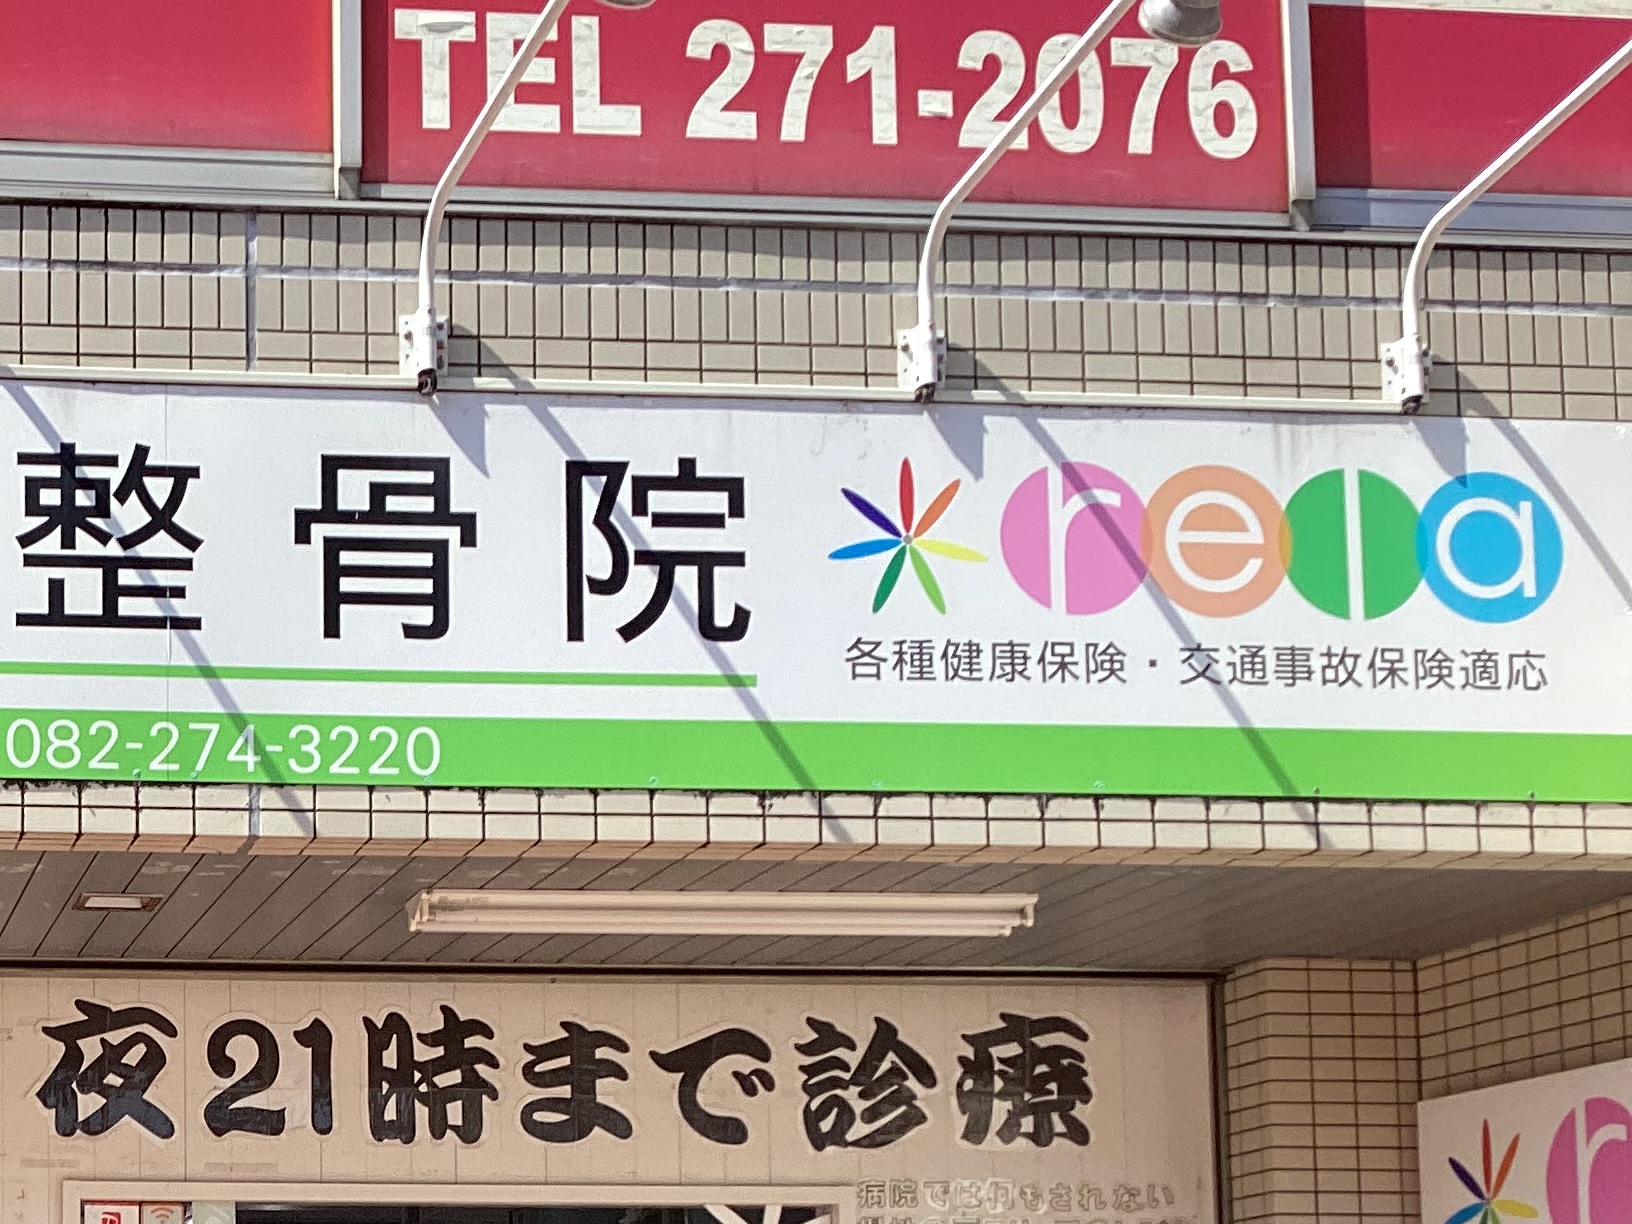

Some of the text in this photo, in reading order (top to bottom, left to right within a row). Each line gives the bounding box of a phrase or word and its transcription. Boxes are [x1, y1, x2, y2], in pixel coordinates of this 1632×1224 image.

[394, 9, 1261, 160] TEL 271-2076
[1047, 464, 1540, 622] rela
[844, 638, 1550, 692] 各種健康保険・交通事故保険適応
[38, 998, 1092, 1152] 夜21時まで診療
[856, 1177, 1175, 1214] 病院では何もされない
